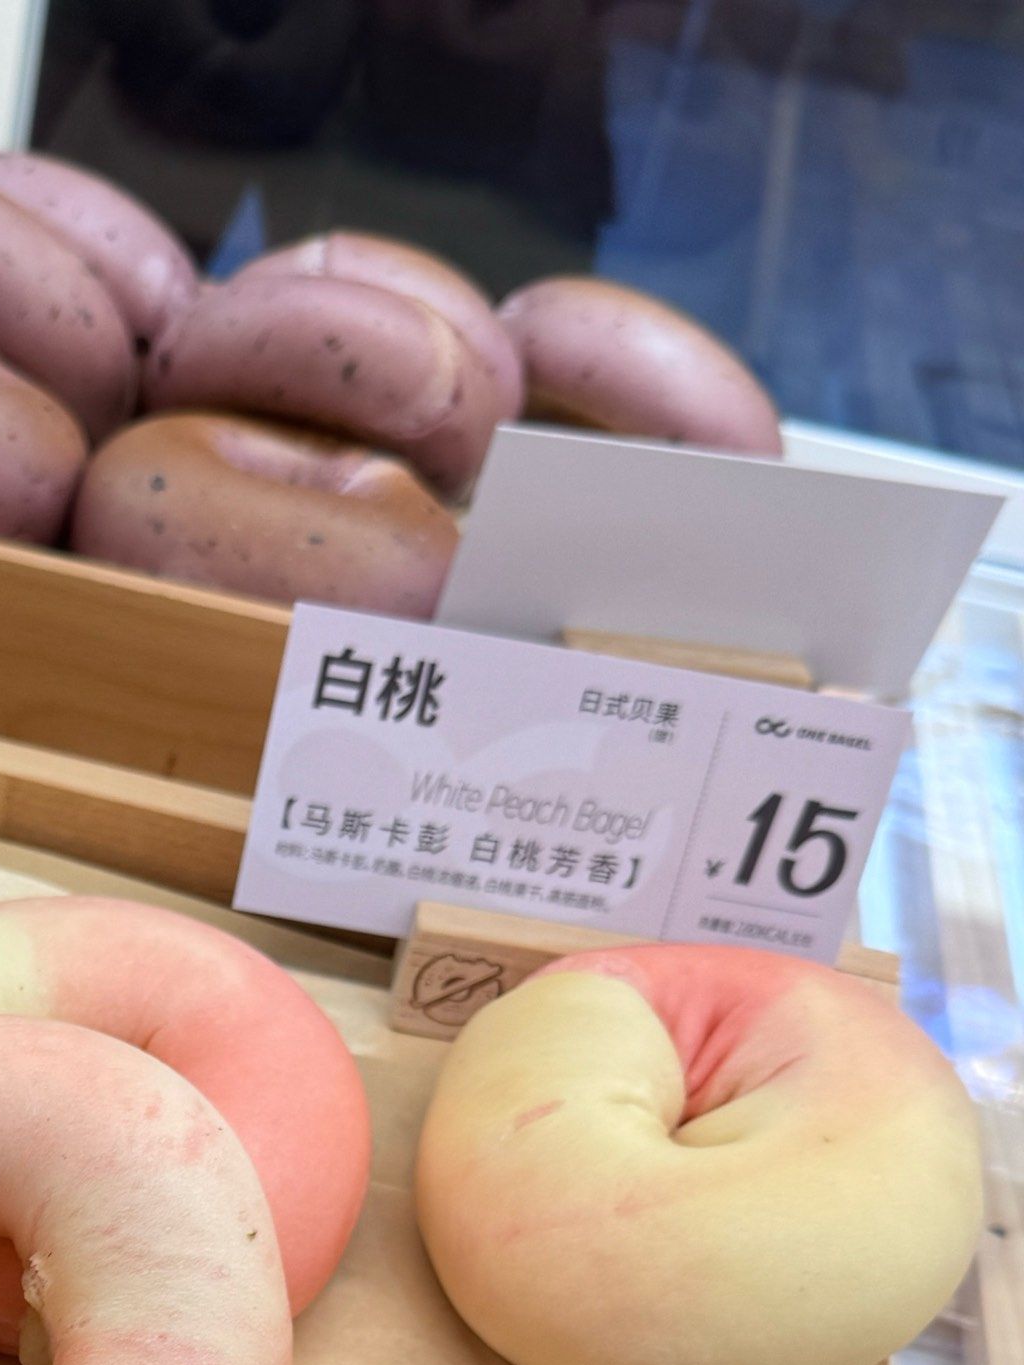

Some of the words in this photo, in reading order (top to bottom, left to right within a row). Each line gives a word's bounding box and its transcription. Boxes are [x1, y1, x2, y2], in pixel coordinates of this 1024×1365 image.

[311, 648, 445, 728] 白桃
[577, 689, 680, 728] 日式贝果
[409, 771, 482, 813] White
[484, 784, 570, 829] Peach
[575, 799, 653, 846] Bagel
